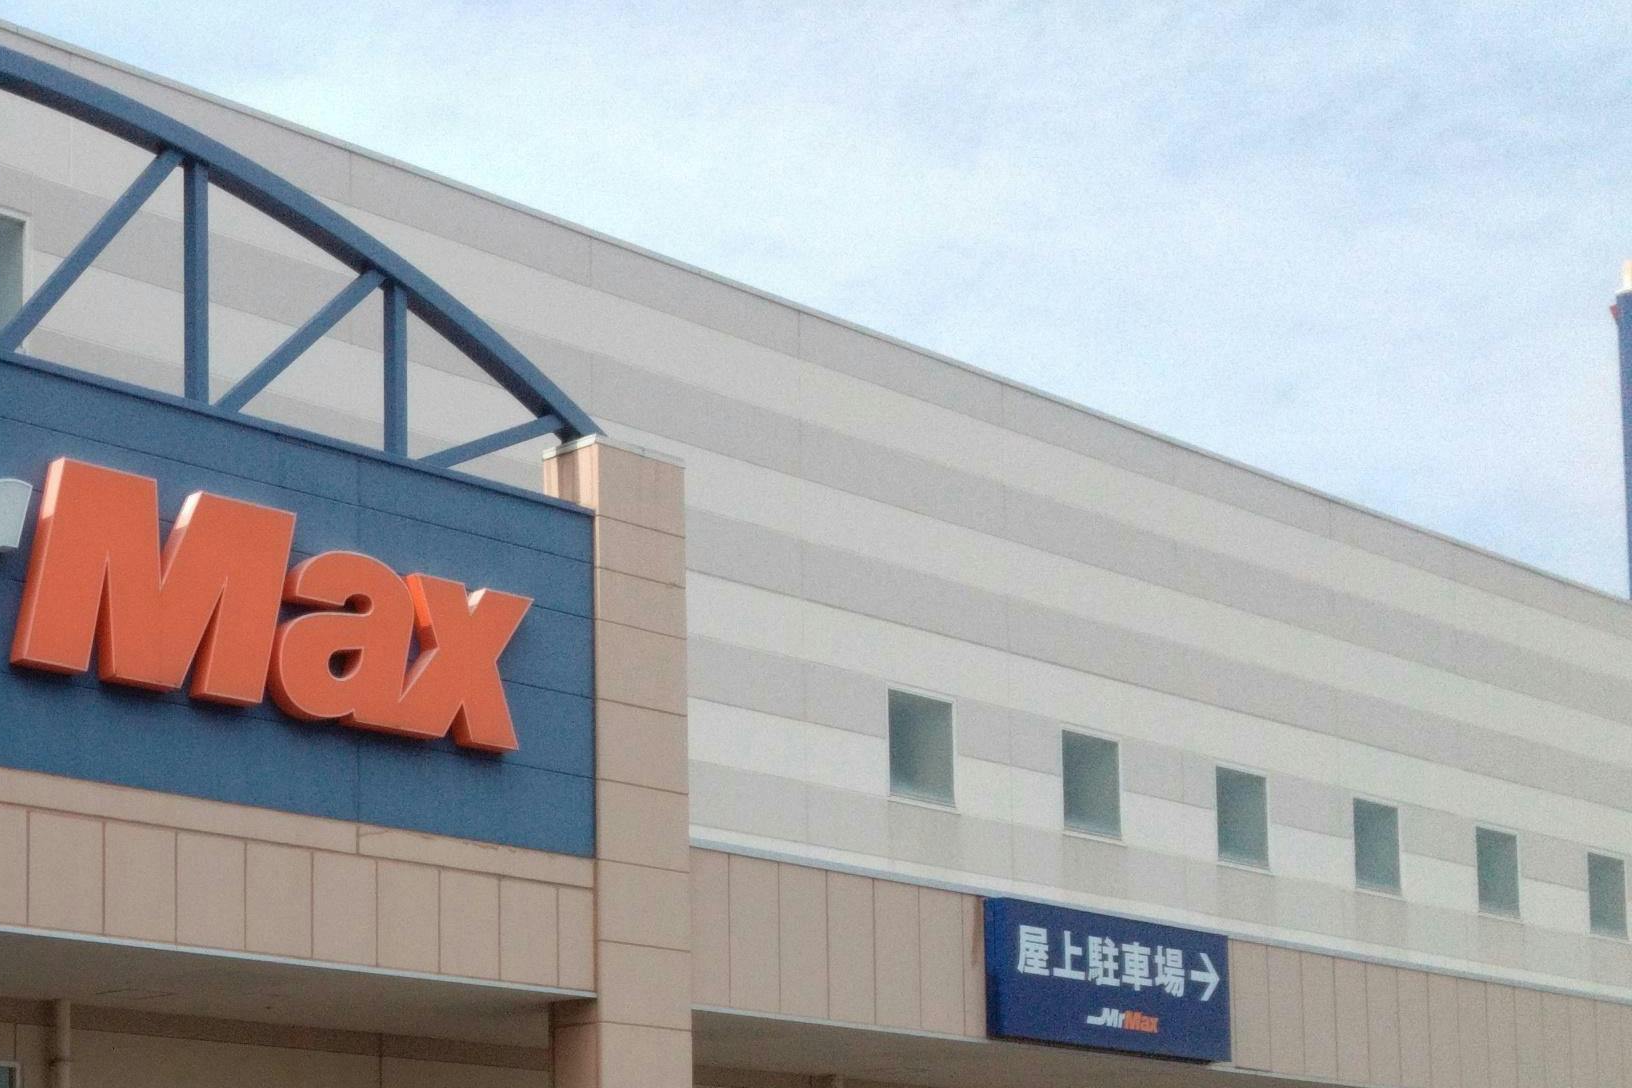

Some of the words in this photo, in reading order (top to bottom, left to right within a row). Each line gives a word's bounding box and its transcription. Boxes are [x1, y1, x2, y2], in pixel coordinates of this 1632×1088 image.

[1017, 924, 1185, 998] 屋上駐車場
[1086, 1007, 1159, 1034] MrMax
